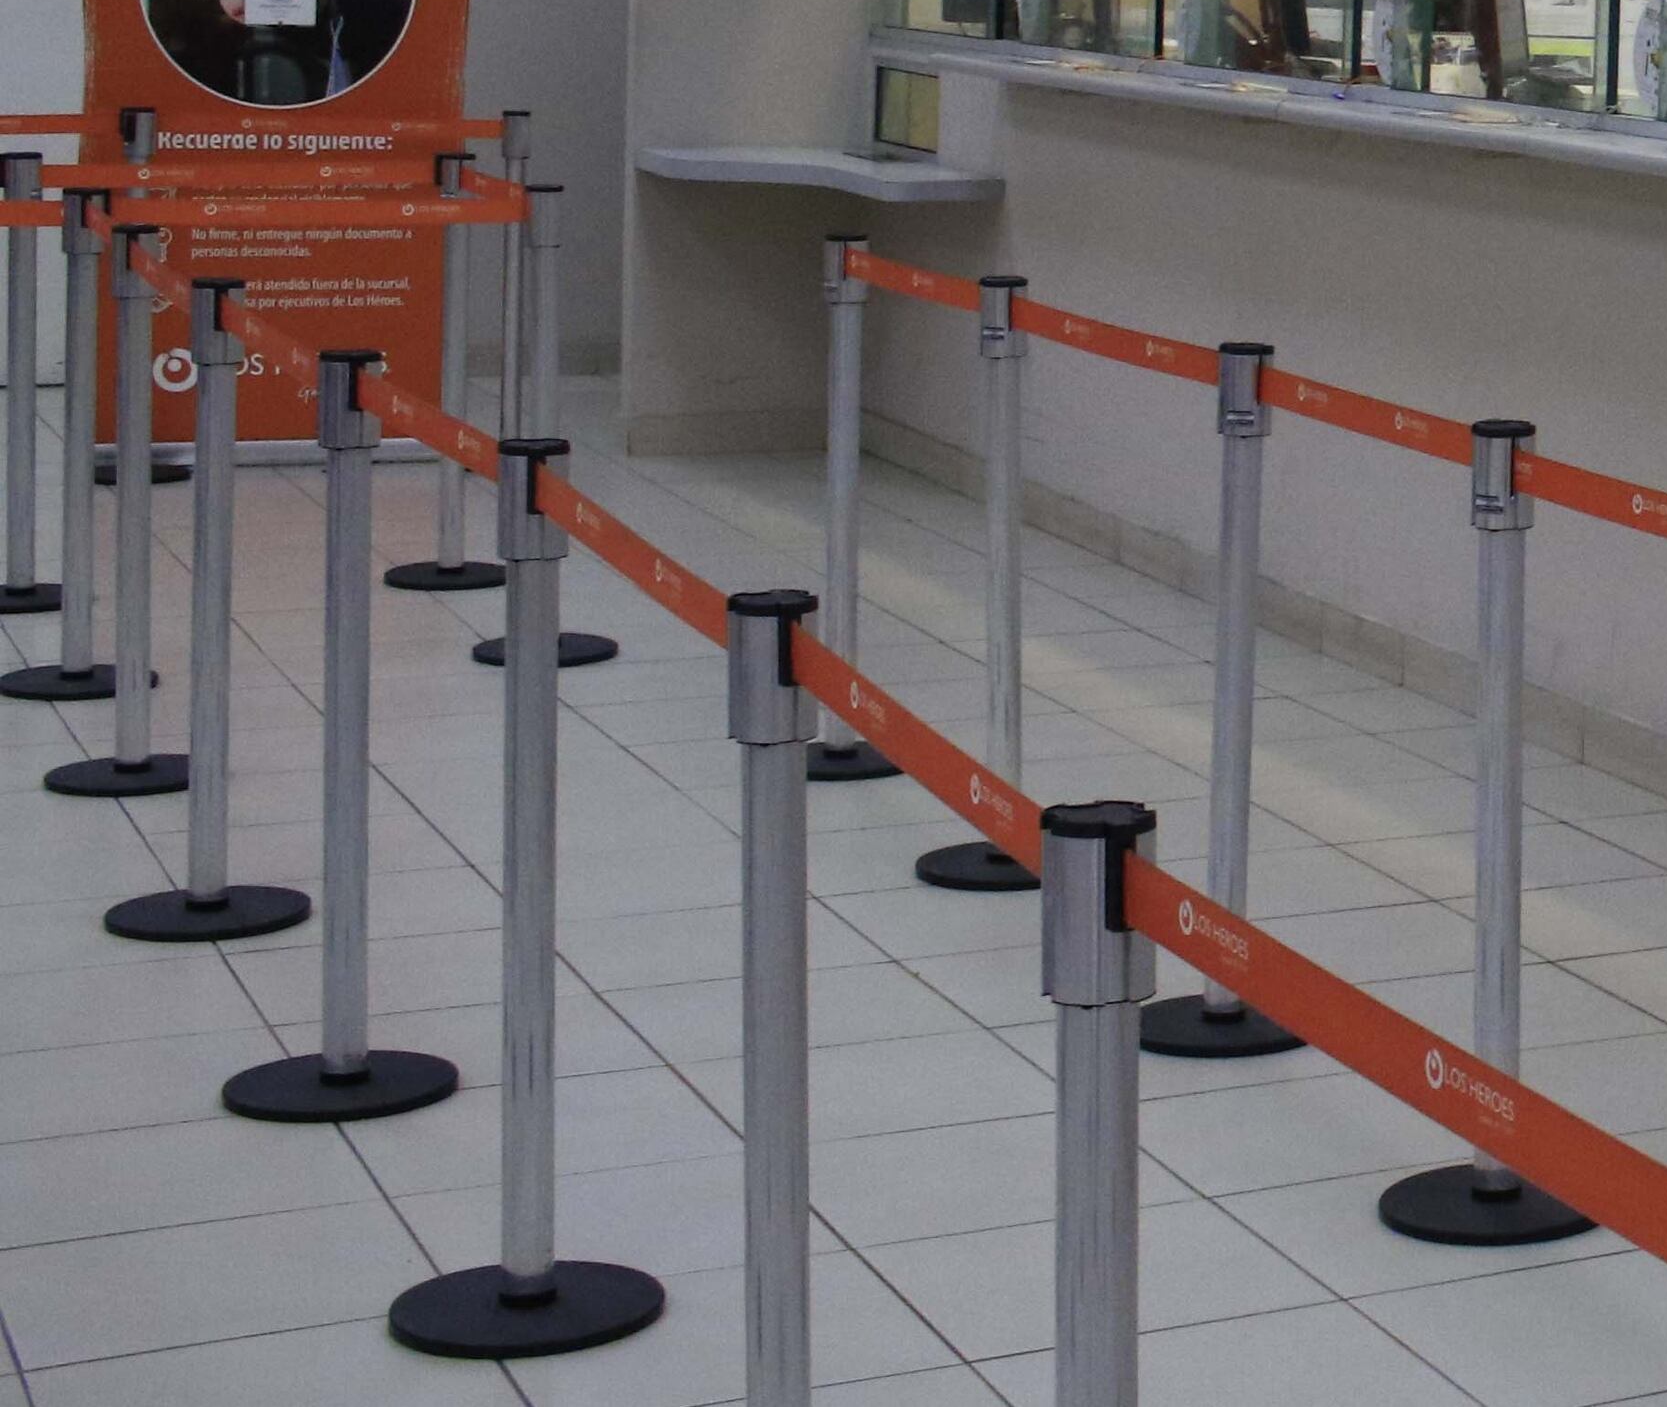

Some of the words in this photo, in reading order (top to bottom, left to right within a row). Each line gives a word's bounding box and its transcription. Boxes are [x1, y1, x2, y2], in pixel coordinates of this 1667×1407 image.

[158, 131, 257, 150] Recuerde
[264, 277, 310, 291] atendido
[312, 277, 338, 291] fuera
[341, 277, 354, 290] de
[356, 277, 365, 290] la
[258, 297, 277, 310] por
[279, 295, 330, 310] ejecutivos
[332, 295, 345, 308] de
[348, 295, 364, 308] Los
[1193, 911, 1212, 937] LOS
[1213, 924, 1249, 961] HEROES
[1445, 1062, 1467, 1094] LOS
[1469, 1081, 1515, 1122] HEROES
